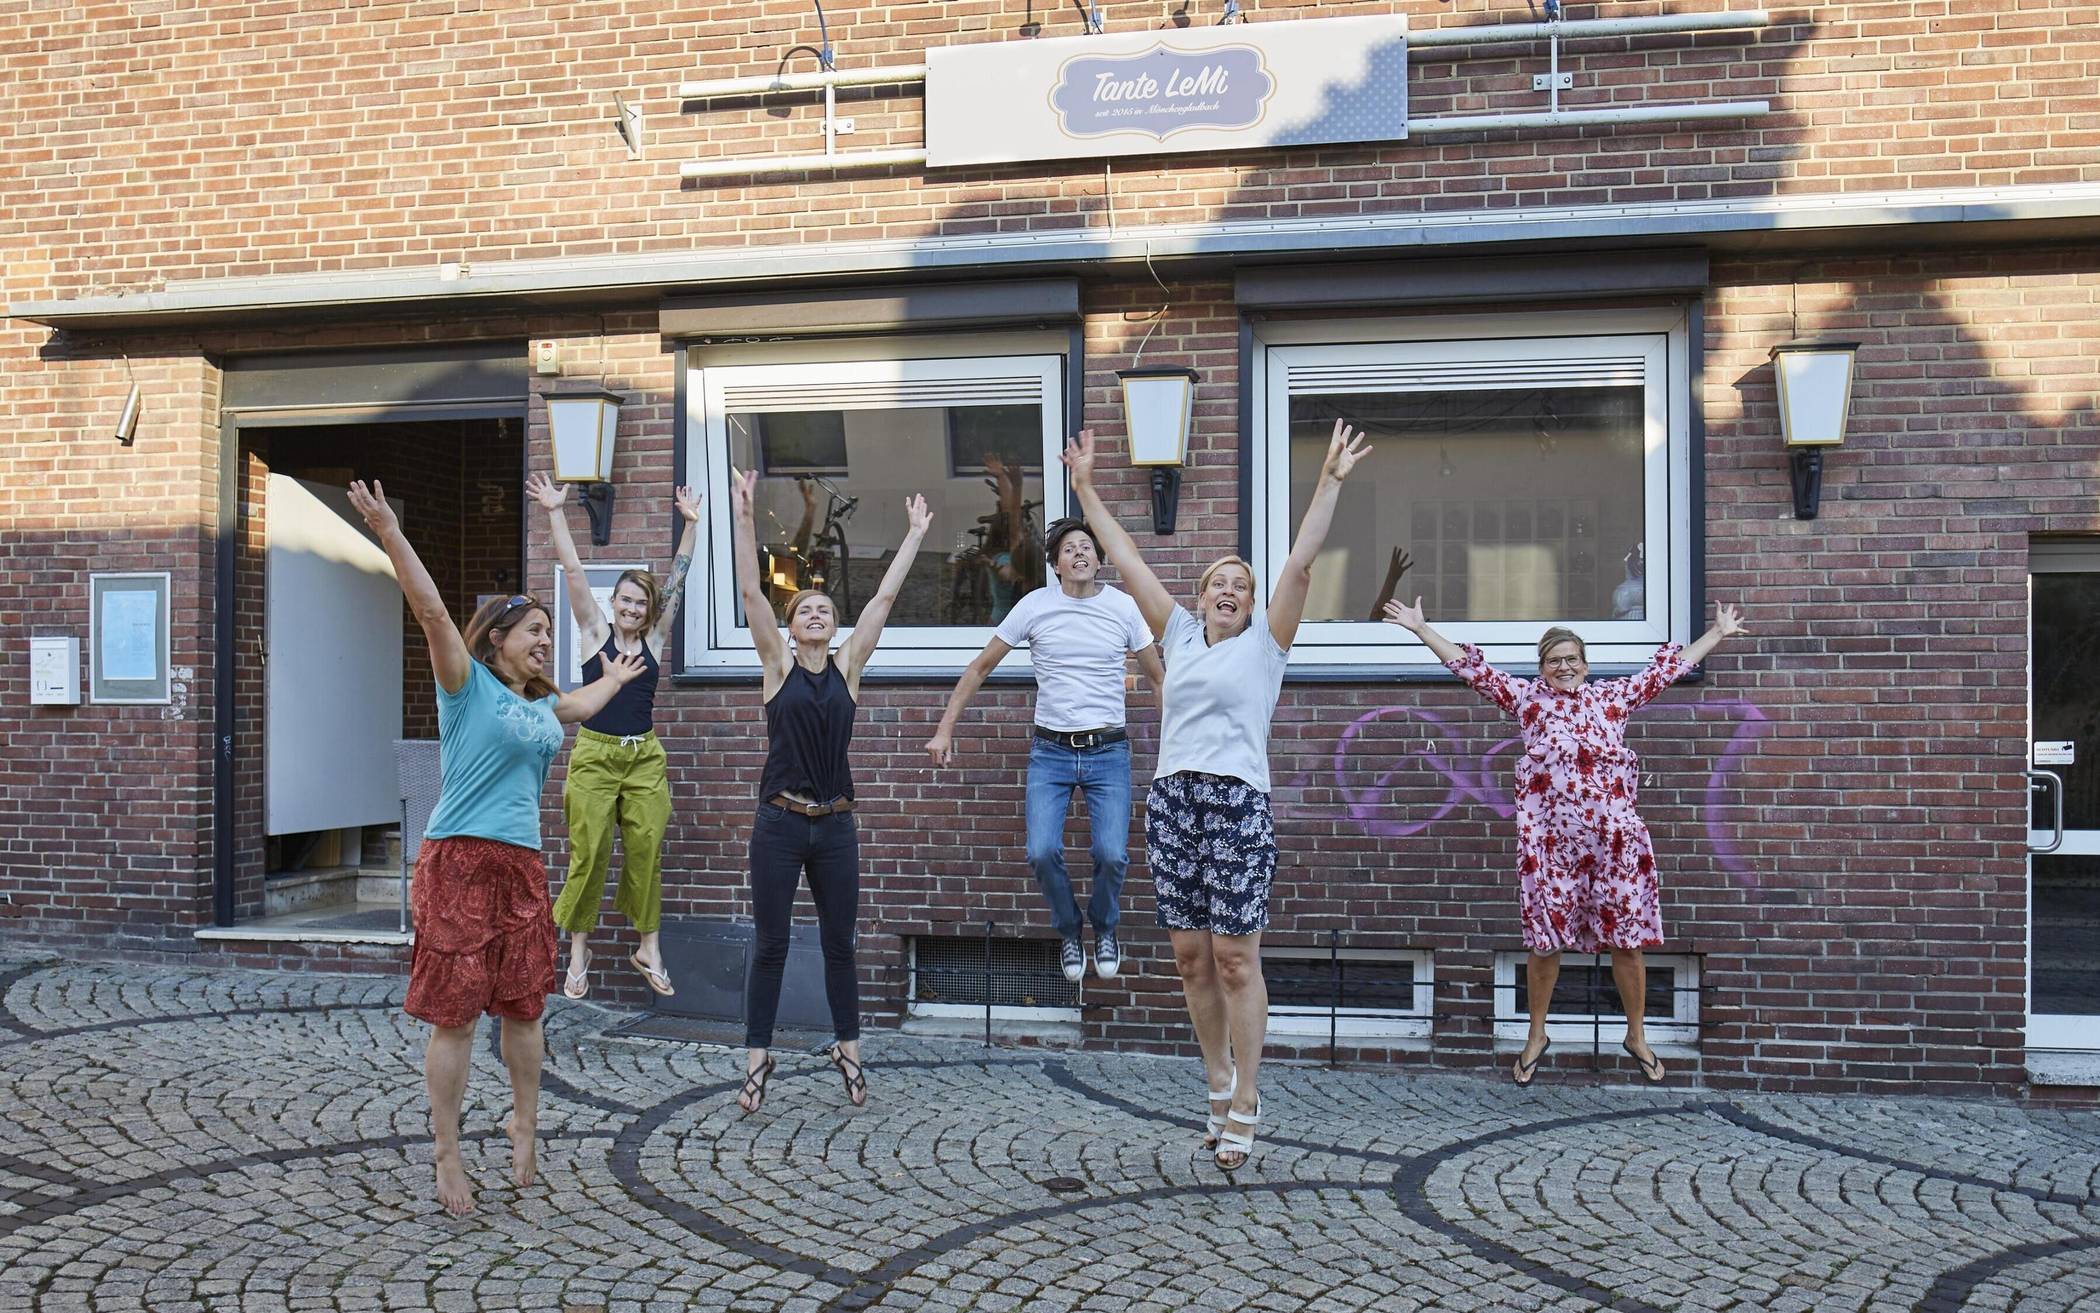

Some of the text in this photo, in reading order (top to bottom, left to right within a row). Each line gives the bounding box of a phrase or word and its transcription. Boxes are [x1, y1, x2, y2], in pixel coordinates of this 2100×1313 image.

[1093, 65, 1229, 102] Tante LeMi
[1145, 101, 1219, 115] Mönchengladbach
